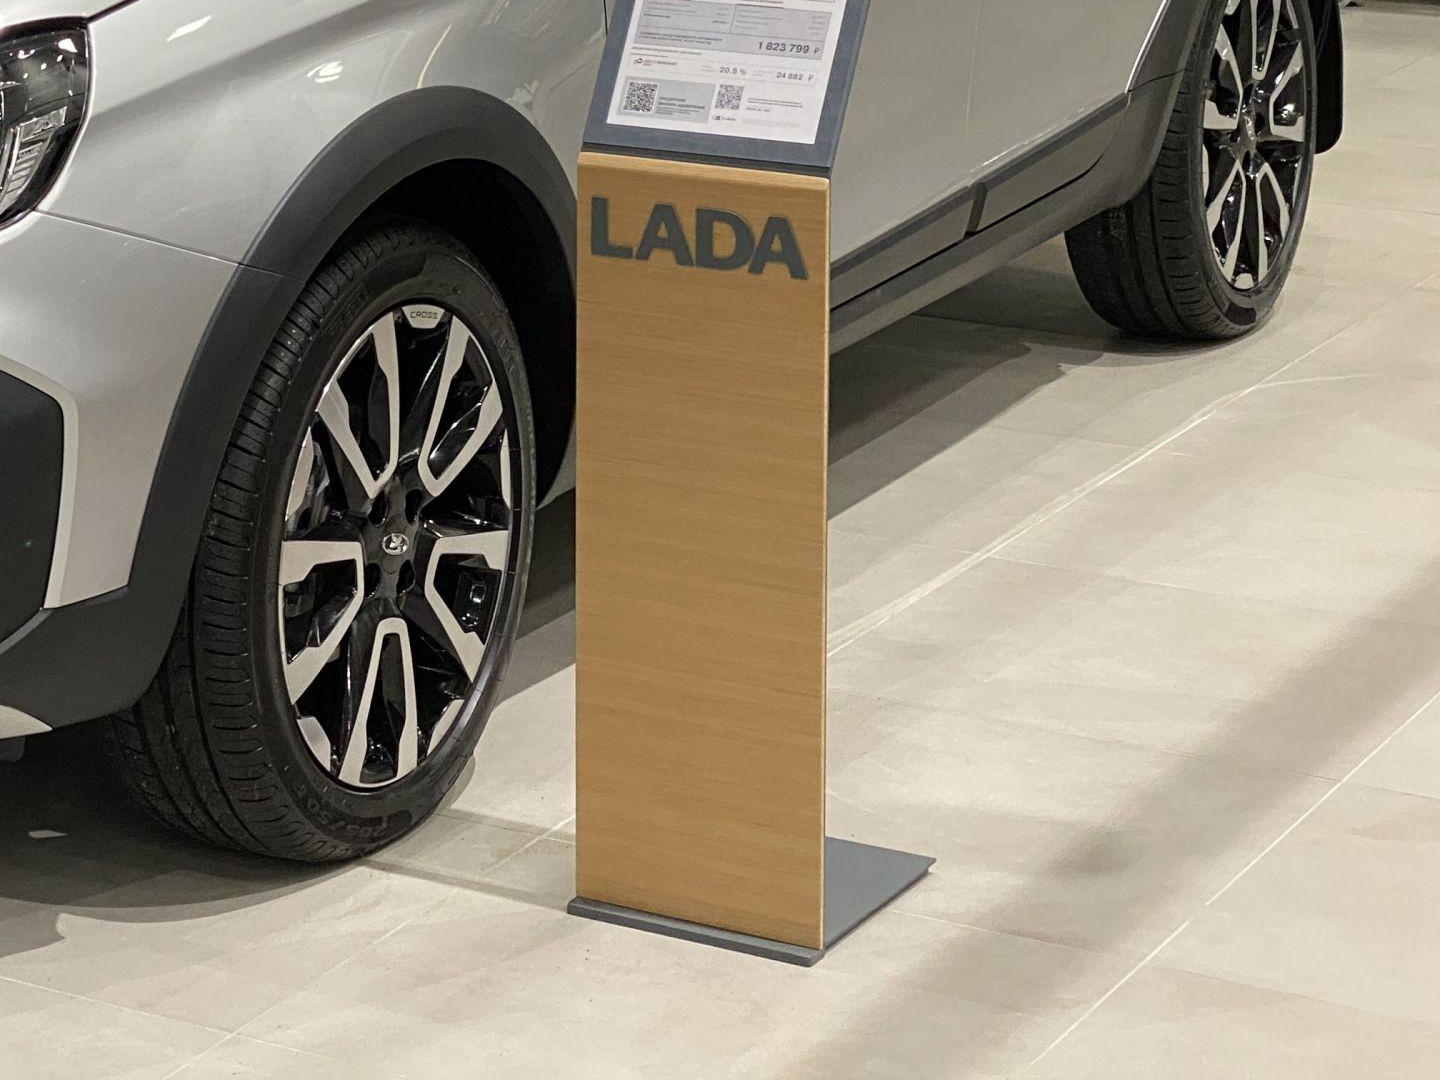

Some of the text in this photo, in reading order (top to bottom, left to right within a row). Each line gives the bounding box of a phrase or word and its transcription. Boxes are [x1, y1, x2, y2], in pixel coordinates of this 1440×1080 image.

[766, 42, 786, 52] 823
[789, 44, 810, 54] 799
[590, 196, 808, 280] LADA
[410, 310, 438, 320] CROSS
